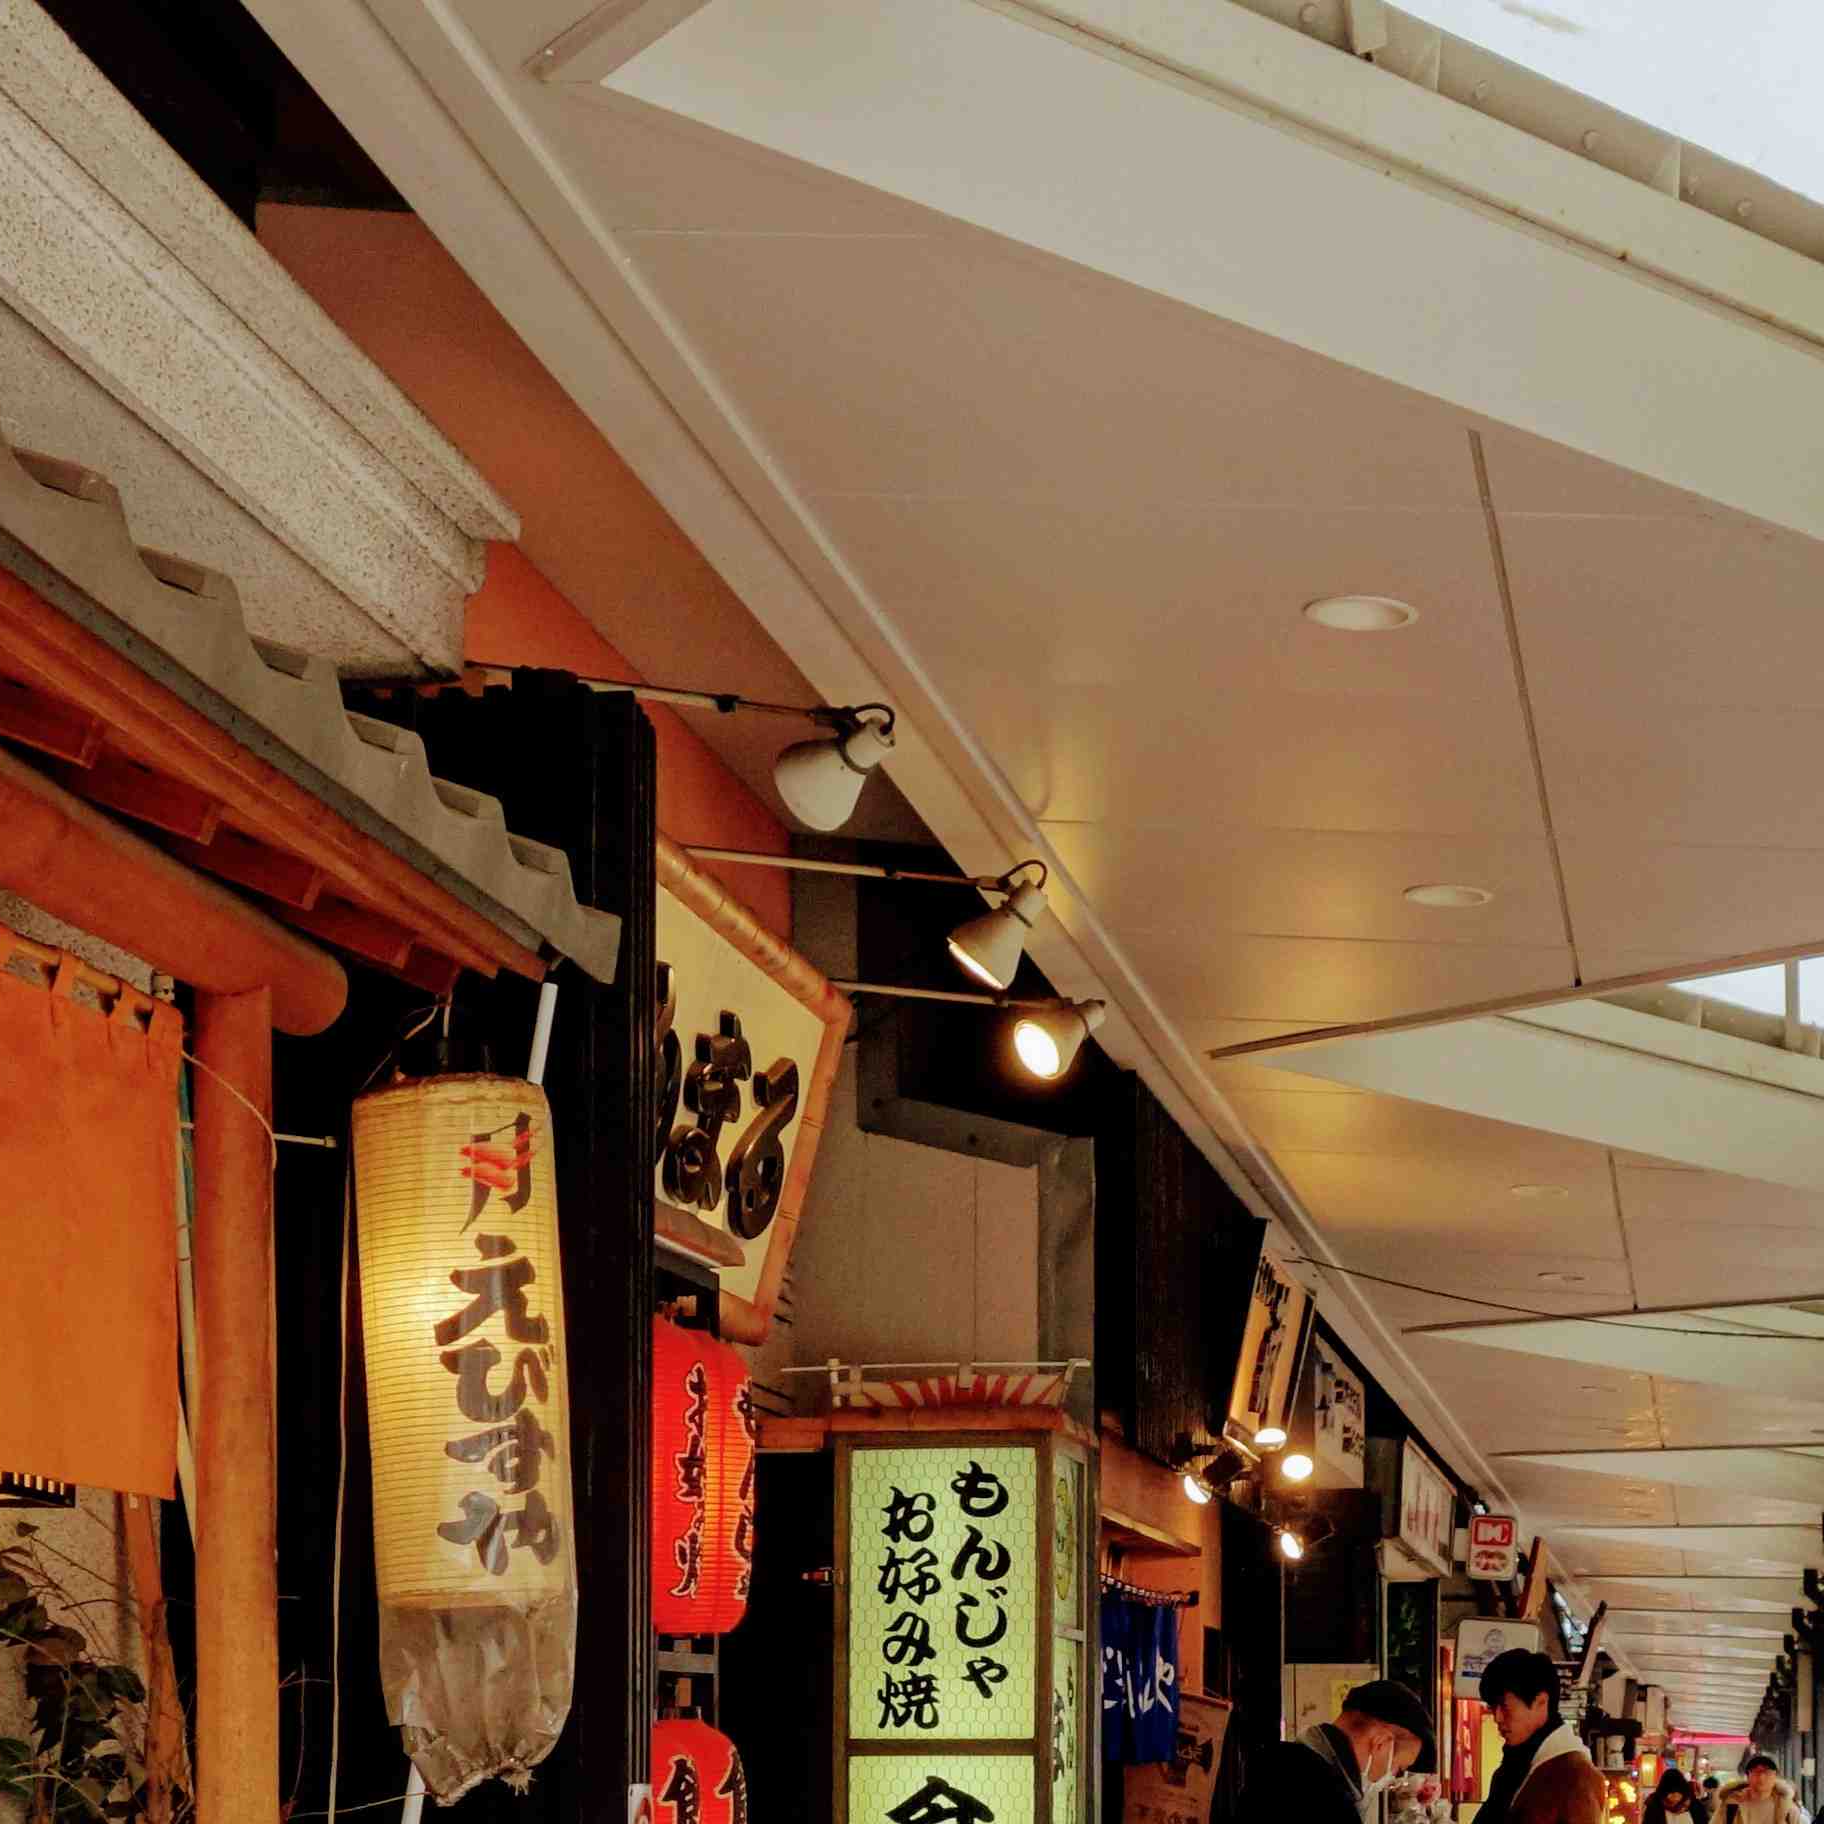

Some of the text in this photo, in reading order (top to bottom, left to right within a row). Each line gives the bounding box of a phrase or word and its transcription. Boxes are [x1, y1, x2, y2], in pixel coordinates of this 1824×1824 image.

[435, 1229, 564, 1578] えびすや
[877, 1485, 942, 1731] お好み焼
[950, 1460, 1012, 1699] もんじゃ
